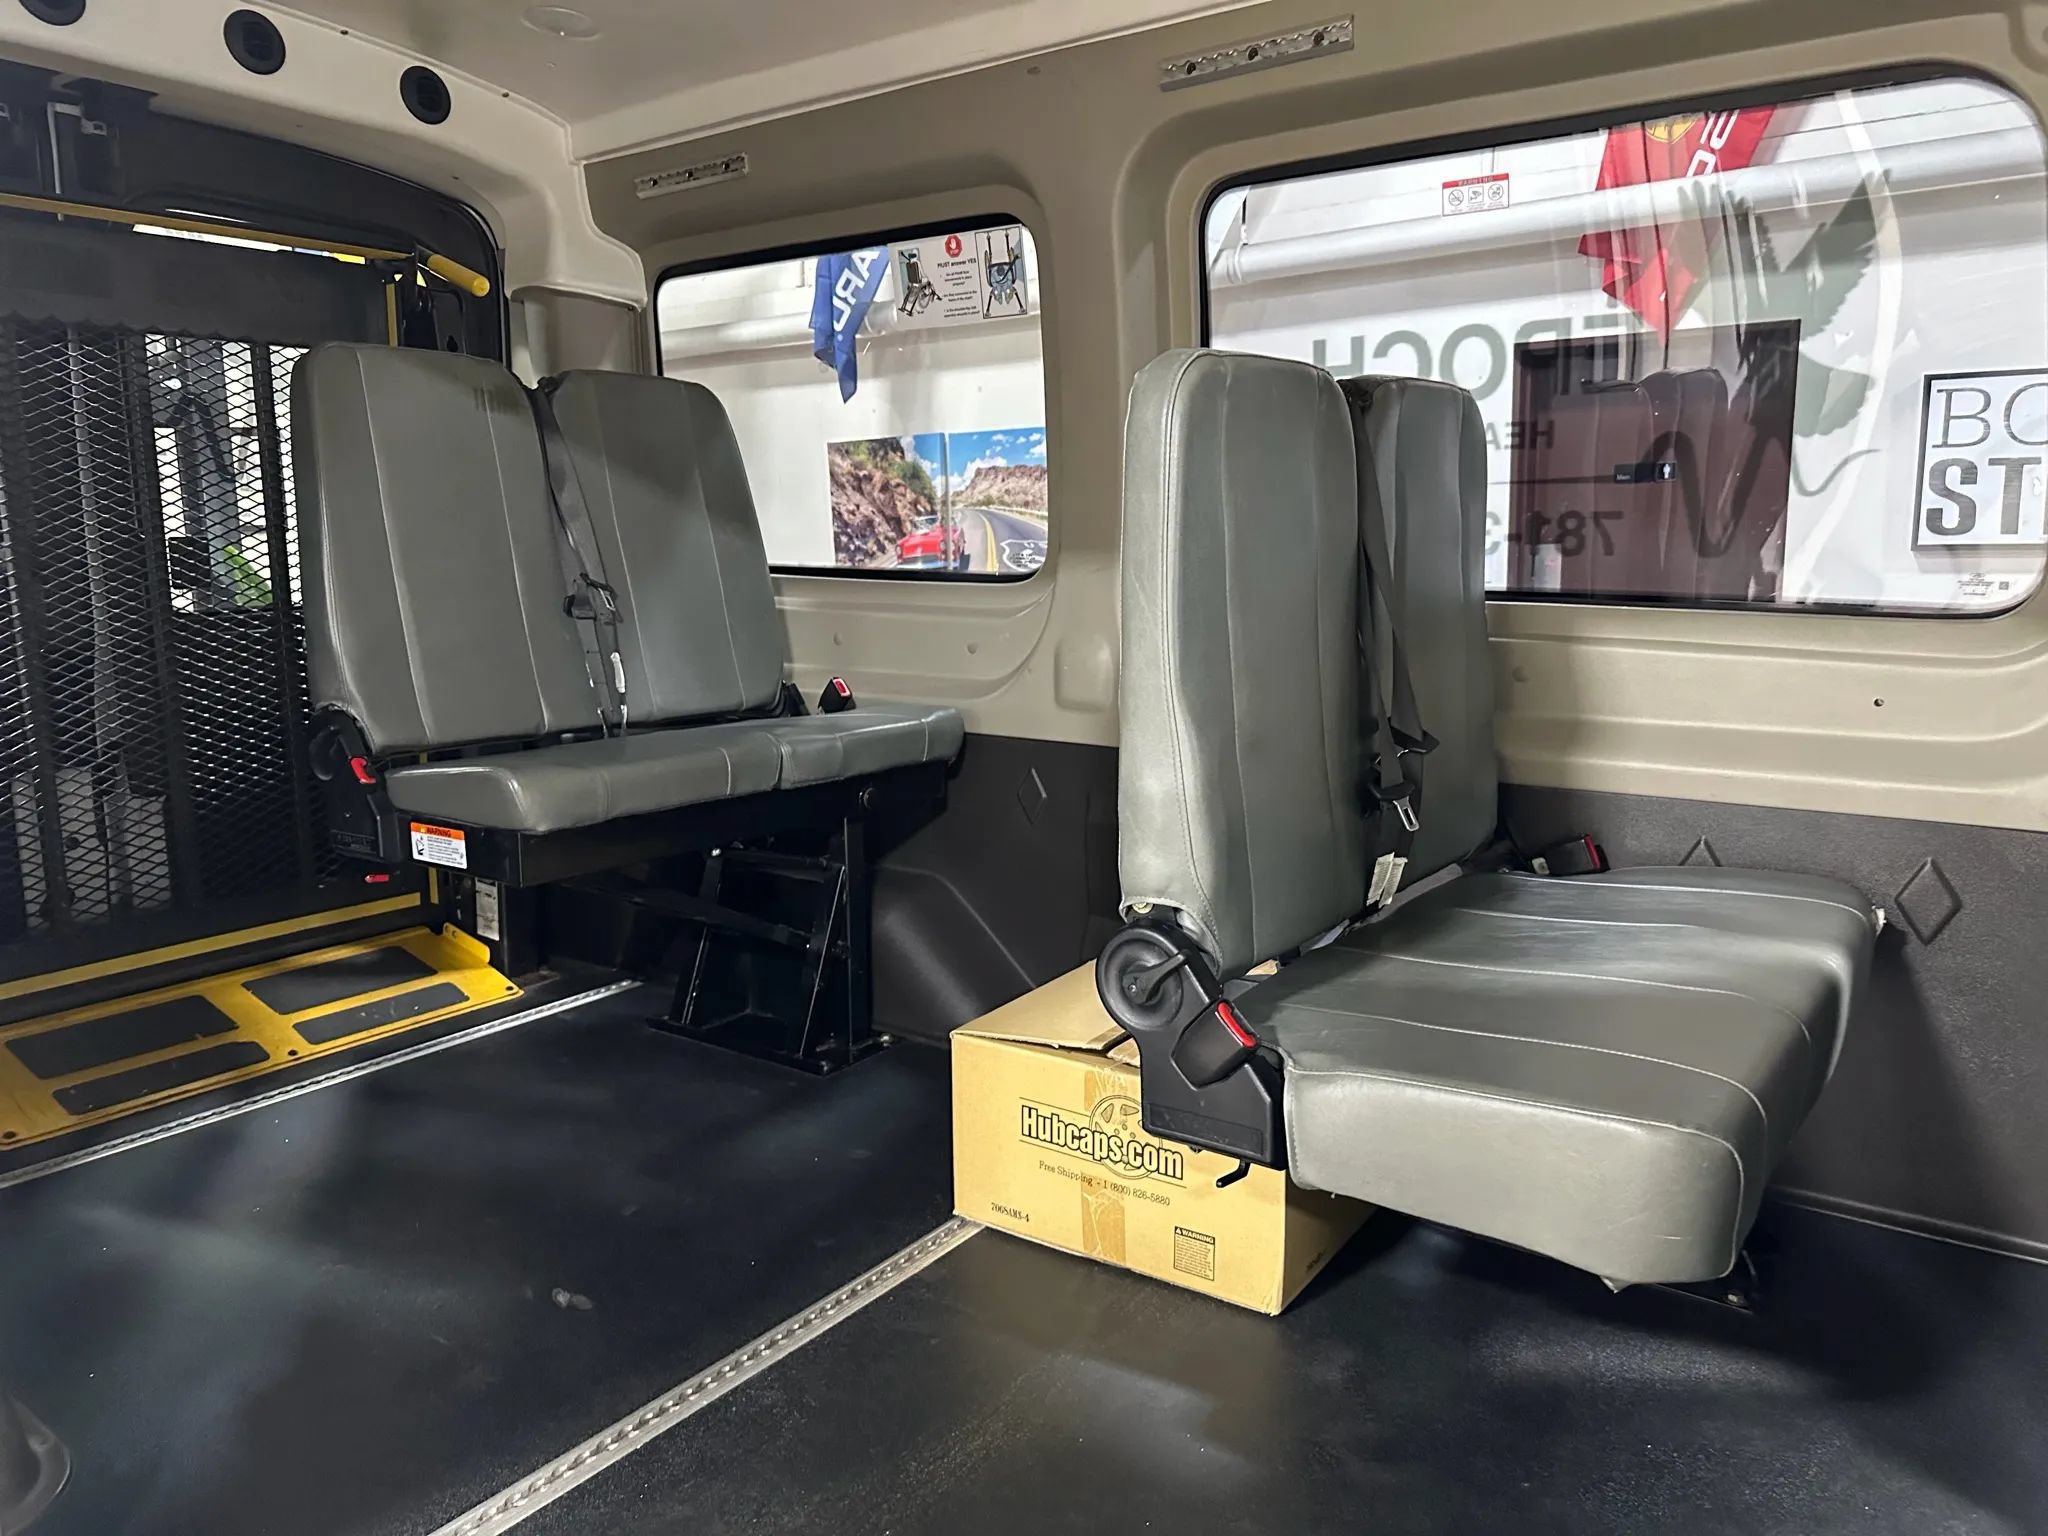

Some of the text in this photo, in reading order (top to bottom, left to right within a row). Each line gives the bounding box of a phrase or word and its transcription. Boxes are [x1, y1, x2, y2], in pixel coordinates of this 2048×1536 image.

[1926, 456, 2048, 536] ST
[1022, 1105, 1184, 1180] Hubcaps.com
[1039, 1160, 1056, 1173] Free
[1057, 1164, 1093, 1187] Shipping
[1110, 1183, 1131, 1197] (800)
[1181, 1229, 1214, 1244] WARNING
